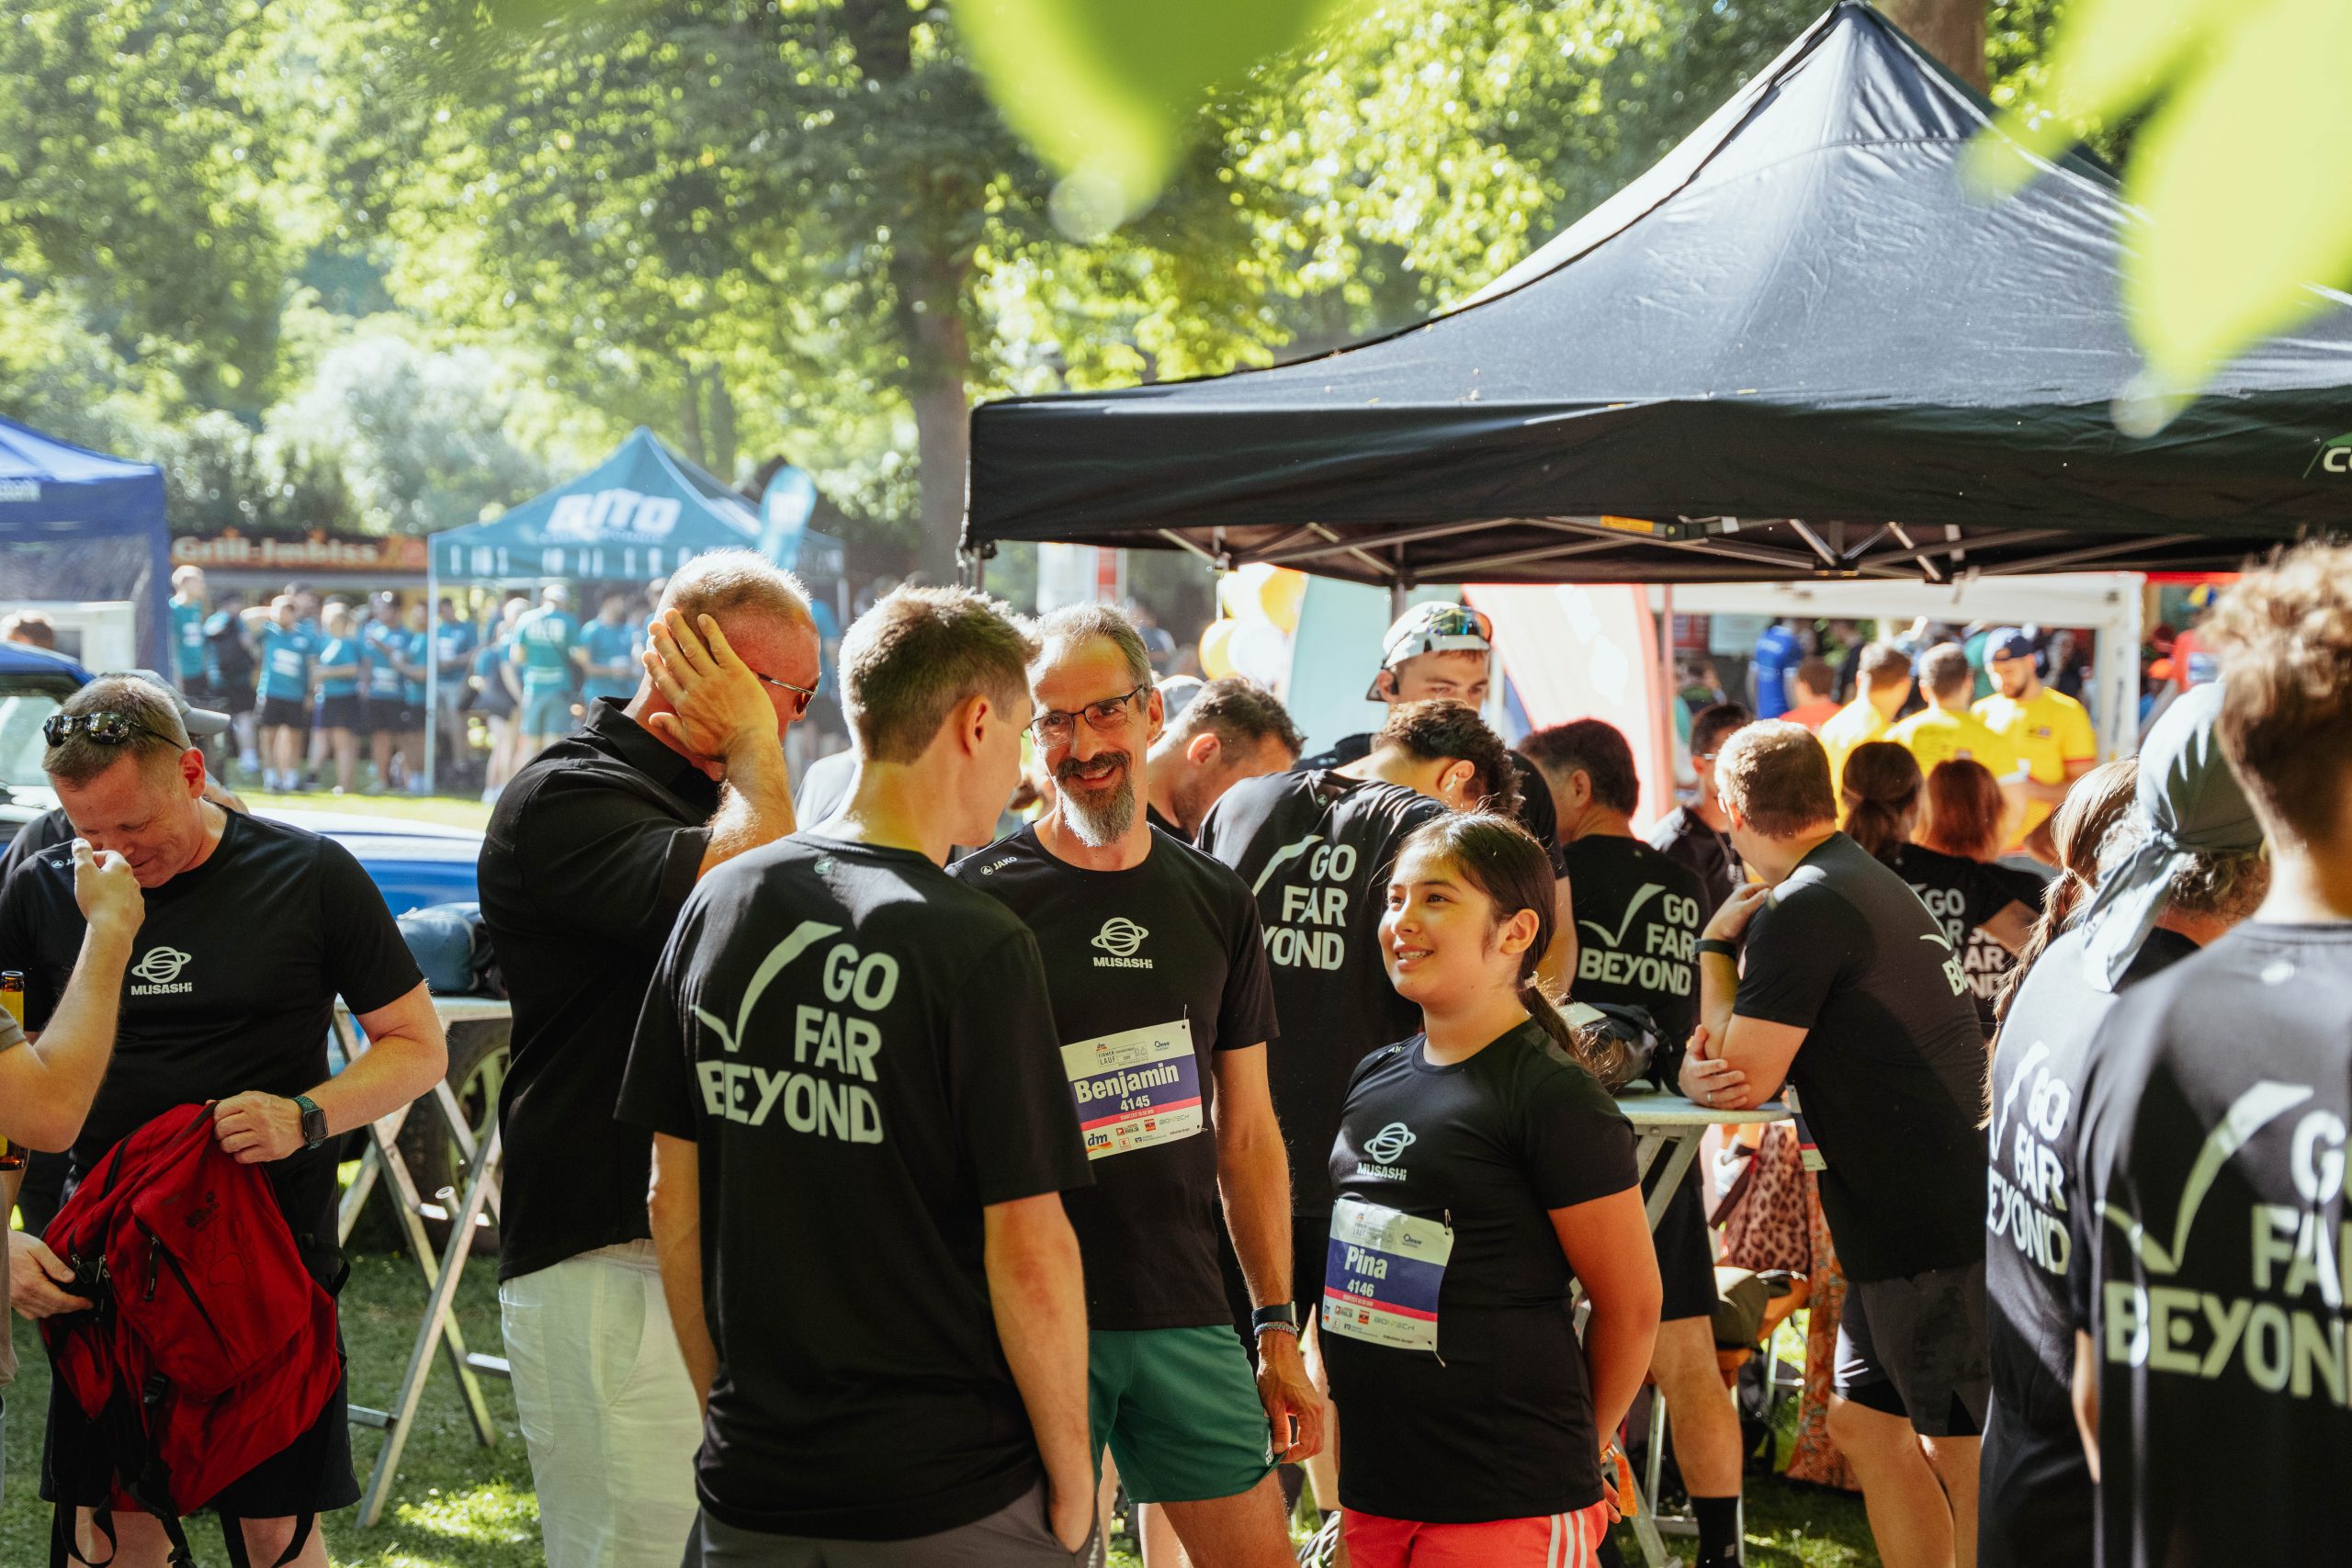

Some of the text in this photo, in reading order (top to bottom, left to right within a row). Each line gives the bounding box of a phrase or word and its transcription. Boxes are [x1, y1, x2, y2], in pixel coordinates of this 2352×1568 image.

[2323, 446, 2352, 473] C
[992, 856, 1017, 871] JAKO
[1309, 843, 1357, 882] GO
[1282, 885, 1349, 927] FAR
[1663, 894, 1700, 929] GO
[1925, 887, 1966, 918] GO
[1645, 921, 1696, 964] FAR
[823, 942, 899, 1011] GO
[1578, 946, 1692, 997] BEYOND
[794, 1004, 883, 1082] FAR
[695, 1059, 884, 1145] BEYOND
[1073, 1062, 1180, 1104] Benjamin
[1120, 1094, 1150, 1111] 4145
[2028, 1066, 2071, 1141] GO
[1088, 1133, 1108, 1146] dm
[2290, 1109, 2352, 1205] G
[2015, 1122, 2068, 1212] FAR
[1344, 1246, 1388, 1280] Pina
[2251, 1204, 2352, 1309] FA
[1347, 1279, 1374, 1298] 4146
[2104, 1280, 2352, 1410] BEYON
